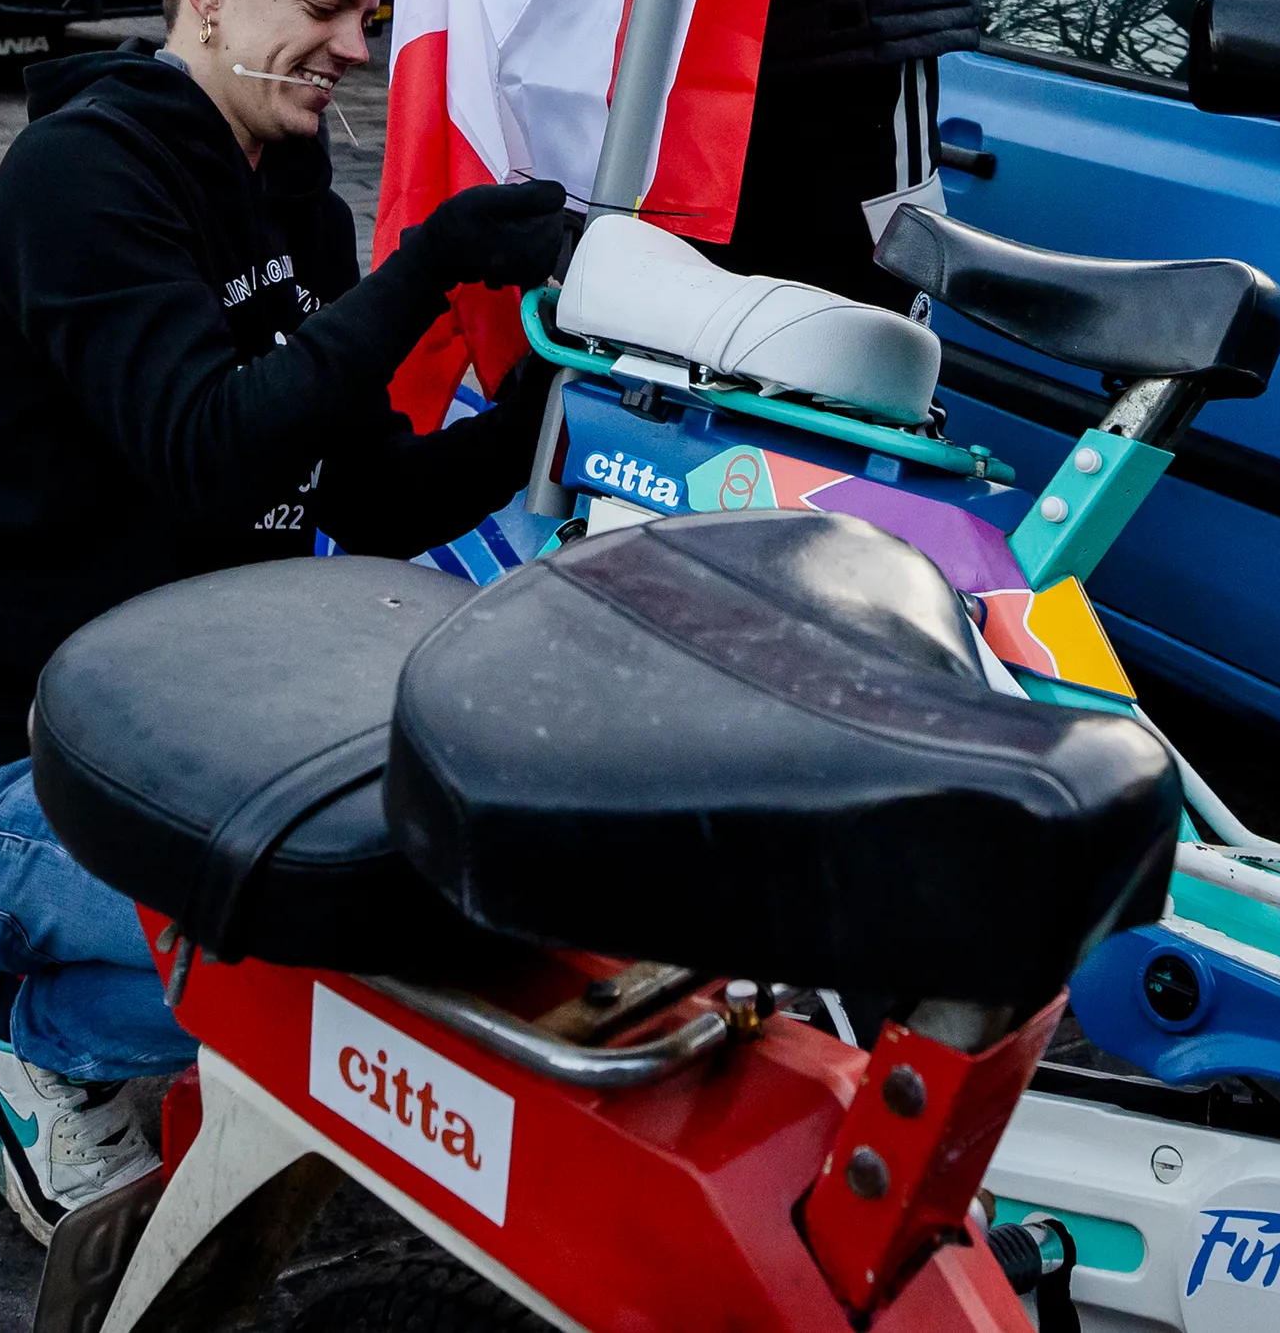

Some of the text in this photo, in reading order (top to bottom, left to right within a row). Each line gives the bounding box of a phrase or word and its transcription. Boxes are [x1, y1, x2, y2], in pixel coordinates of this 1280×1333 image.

[585, 452, 680, 507] citta
[254, 503, 305, 530] 022
[338, 1046, 482, 1172] citta
